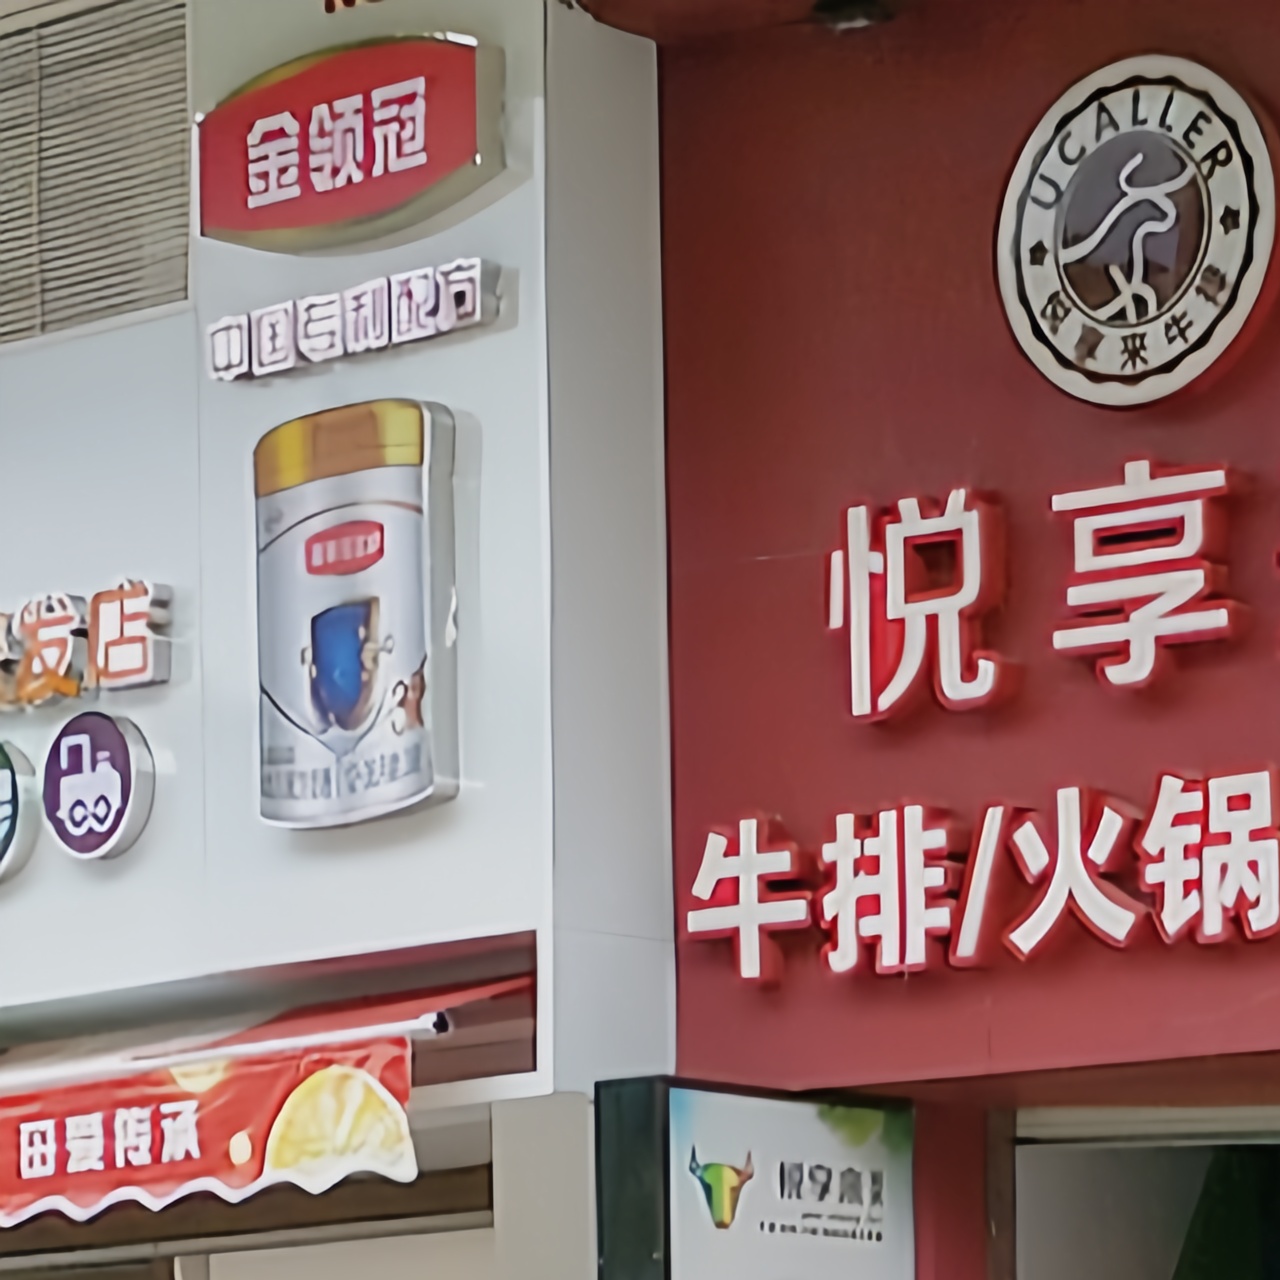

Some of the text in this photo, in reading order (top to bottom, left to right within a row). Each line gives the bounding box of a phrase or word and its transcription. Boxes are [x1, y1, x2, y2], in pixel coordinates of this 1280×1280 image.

[247, 76, 428, 208] 金领冠
[0, 578, 154, 704] 发店
